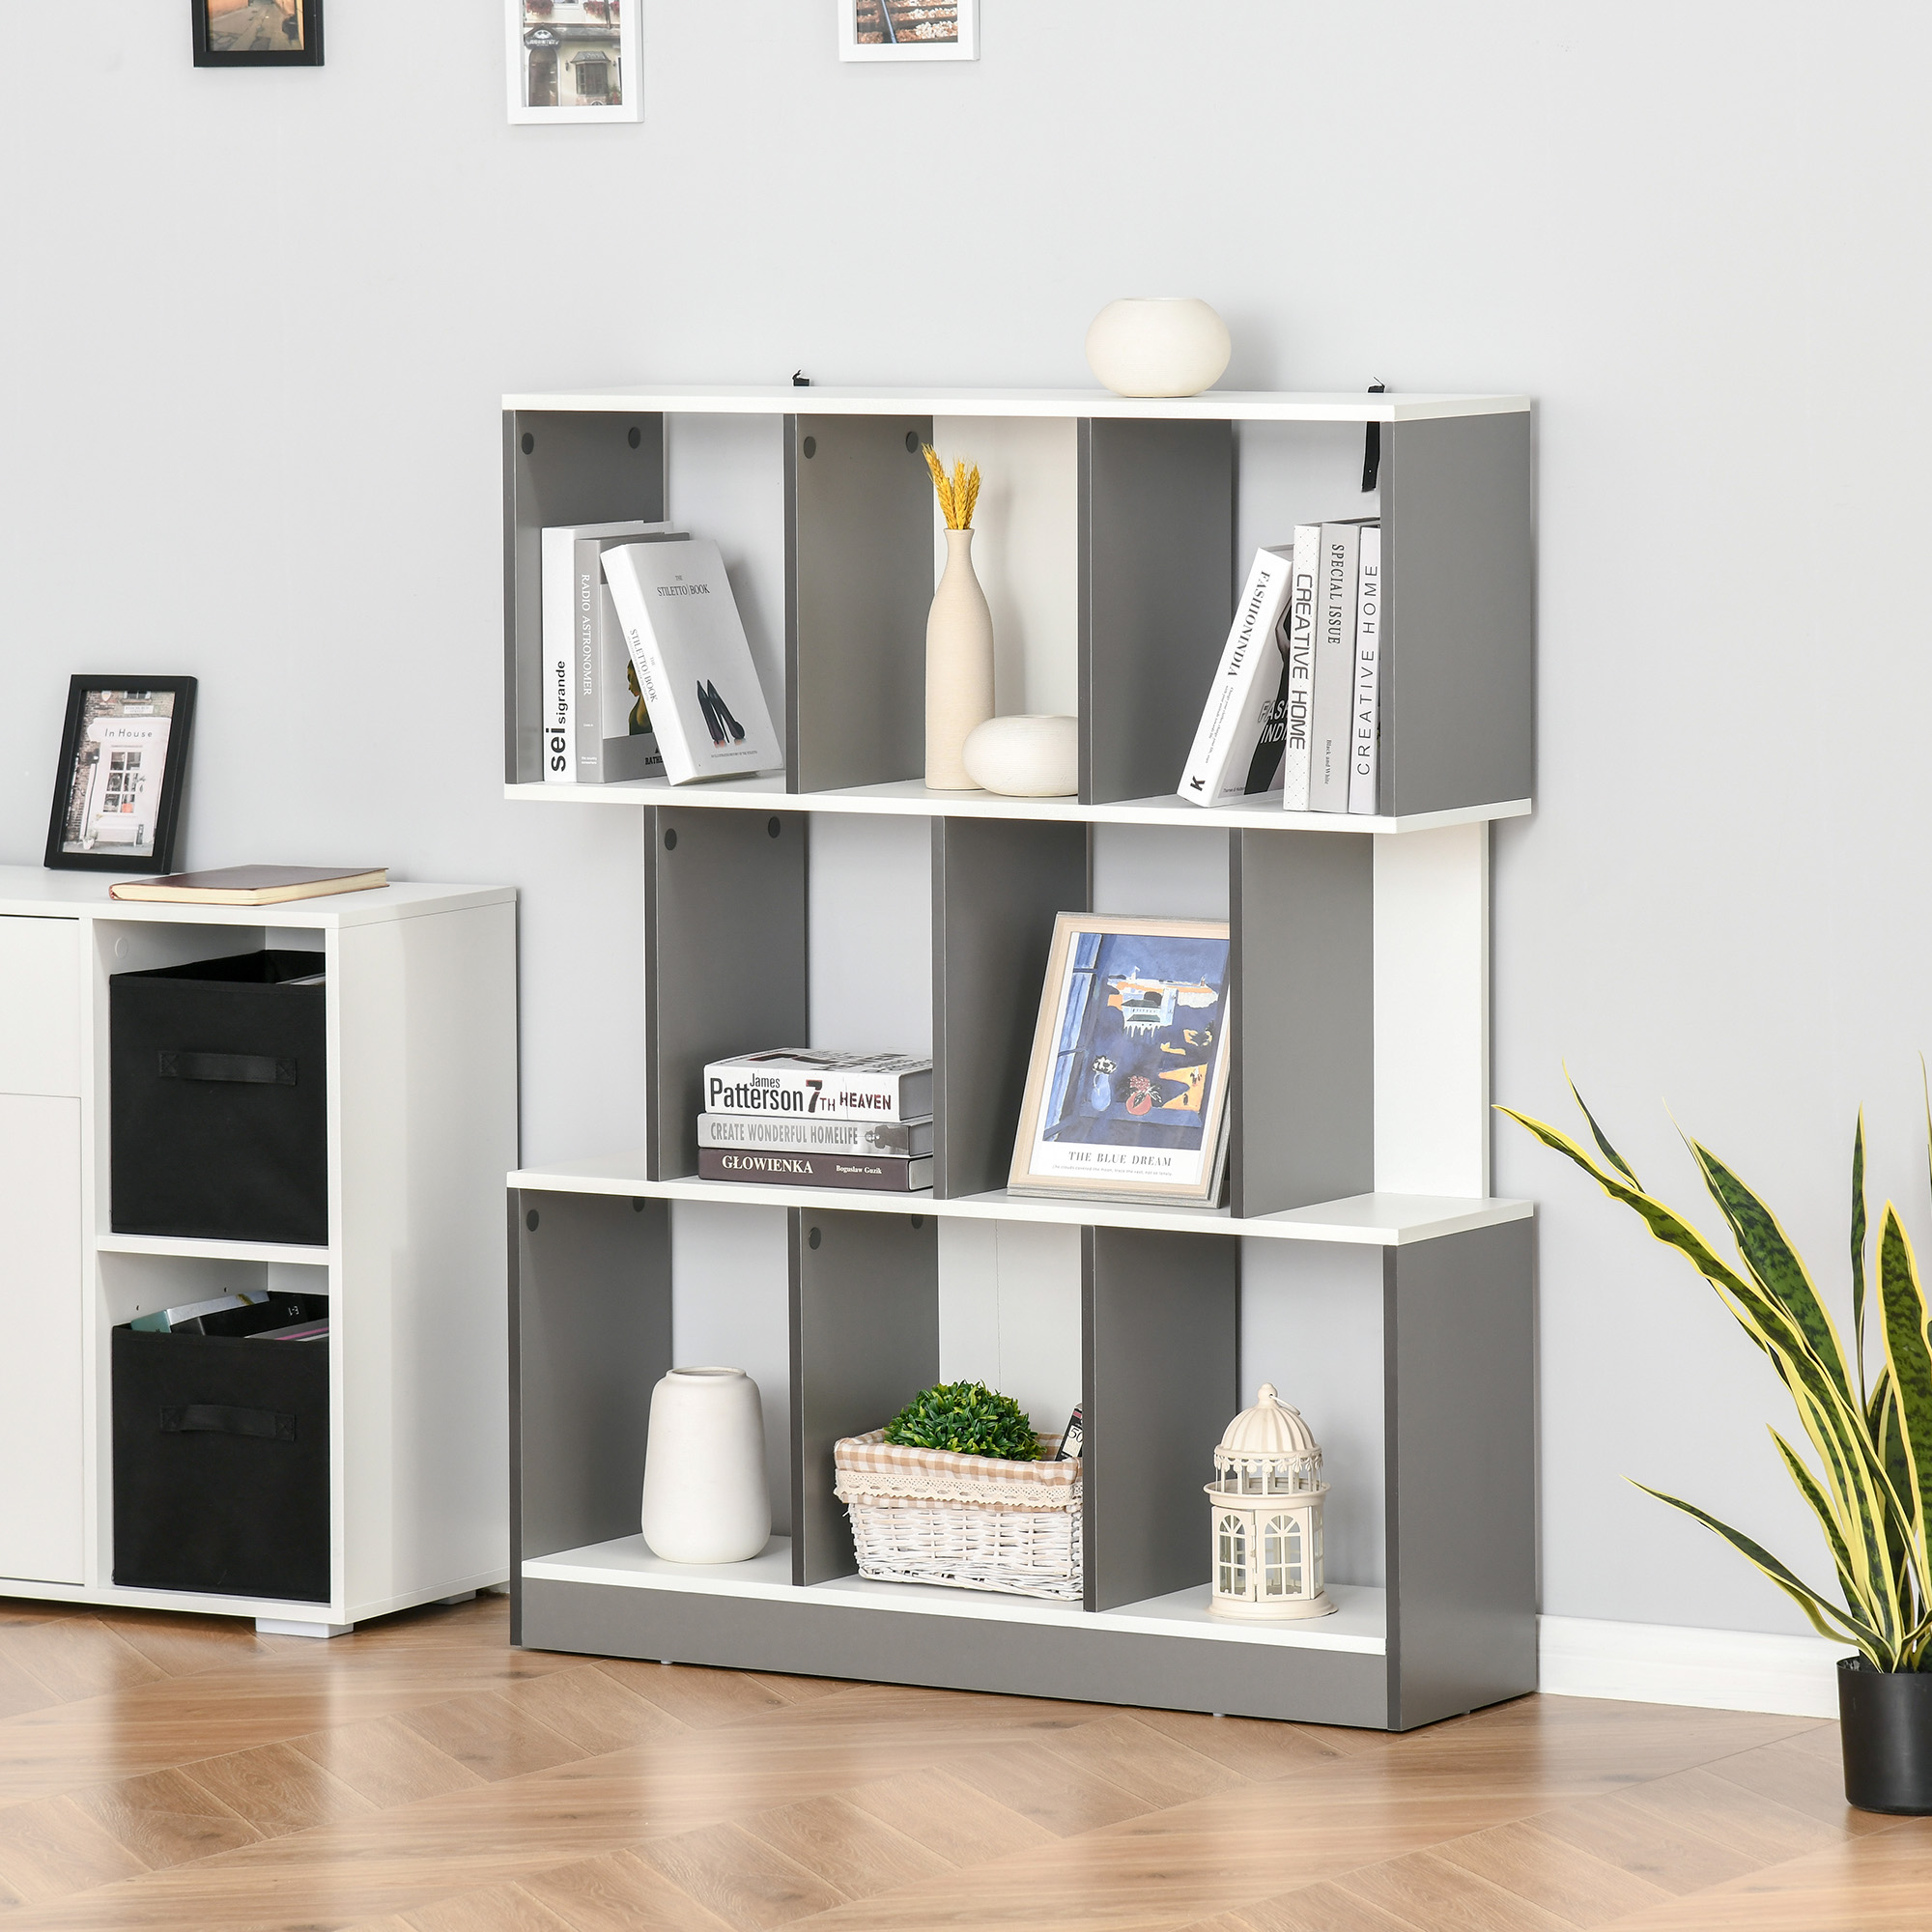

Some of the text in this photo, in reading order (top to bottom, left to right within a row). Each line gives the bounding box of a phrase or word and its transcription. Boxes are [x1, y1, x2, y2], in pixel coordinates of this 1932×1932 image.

[1327, 544, 1345, 645] SPECIAL ISSUE
[582, 574, 592, 696] RADIO ASTRONOMER
[1290, 574, 1313, 750] CREATIVE HOME
[1357, 566, 1378, 775] CREATIVE HOME
[545, 661, 568, 772] sei sigrande
[104, 728, 153, 738] In House
[1190, 775, 1205, 792] K
[749, 1073, 781, 1089] James
[710, 1078, 803, 1111] Patterson
[839, 1091, 892, 1110] HEAVEN
[710, 1122, 858, 1145] CREATE WONDERFUL HOMELIFE
[722, 1155, 814, 1174] GŁOWIENKA
[1068, 1151, 1172, 1167] THE BLUE DREAM
